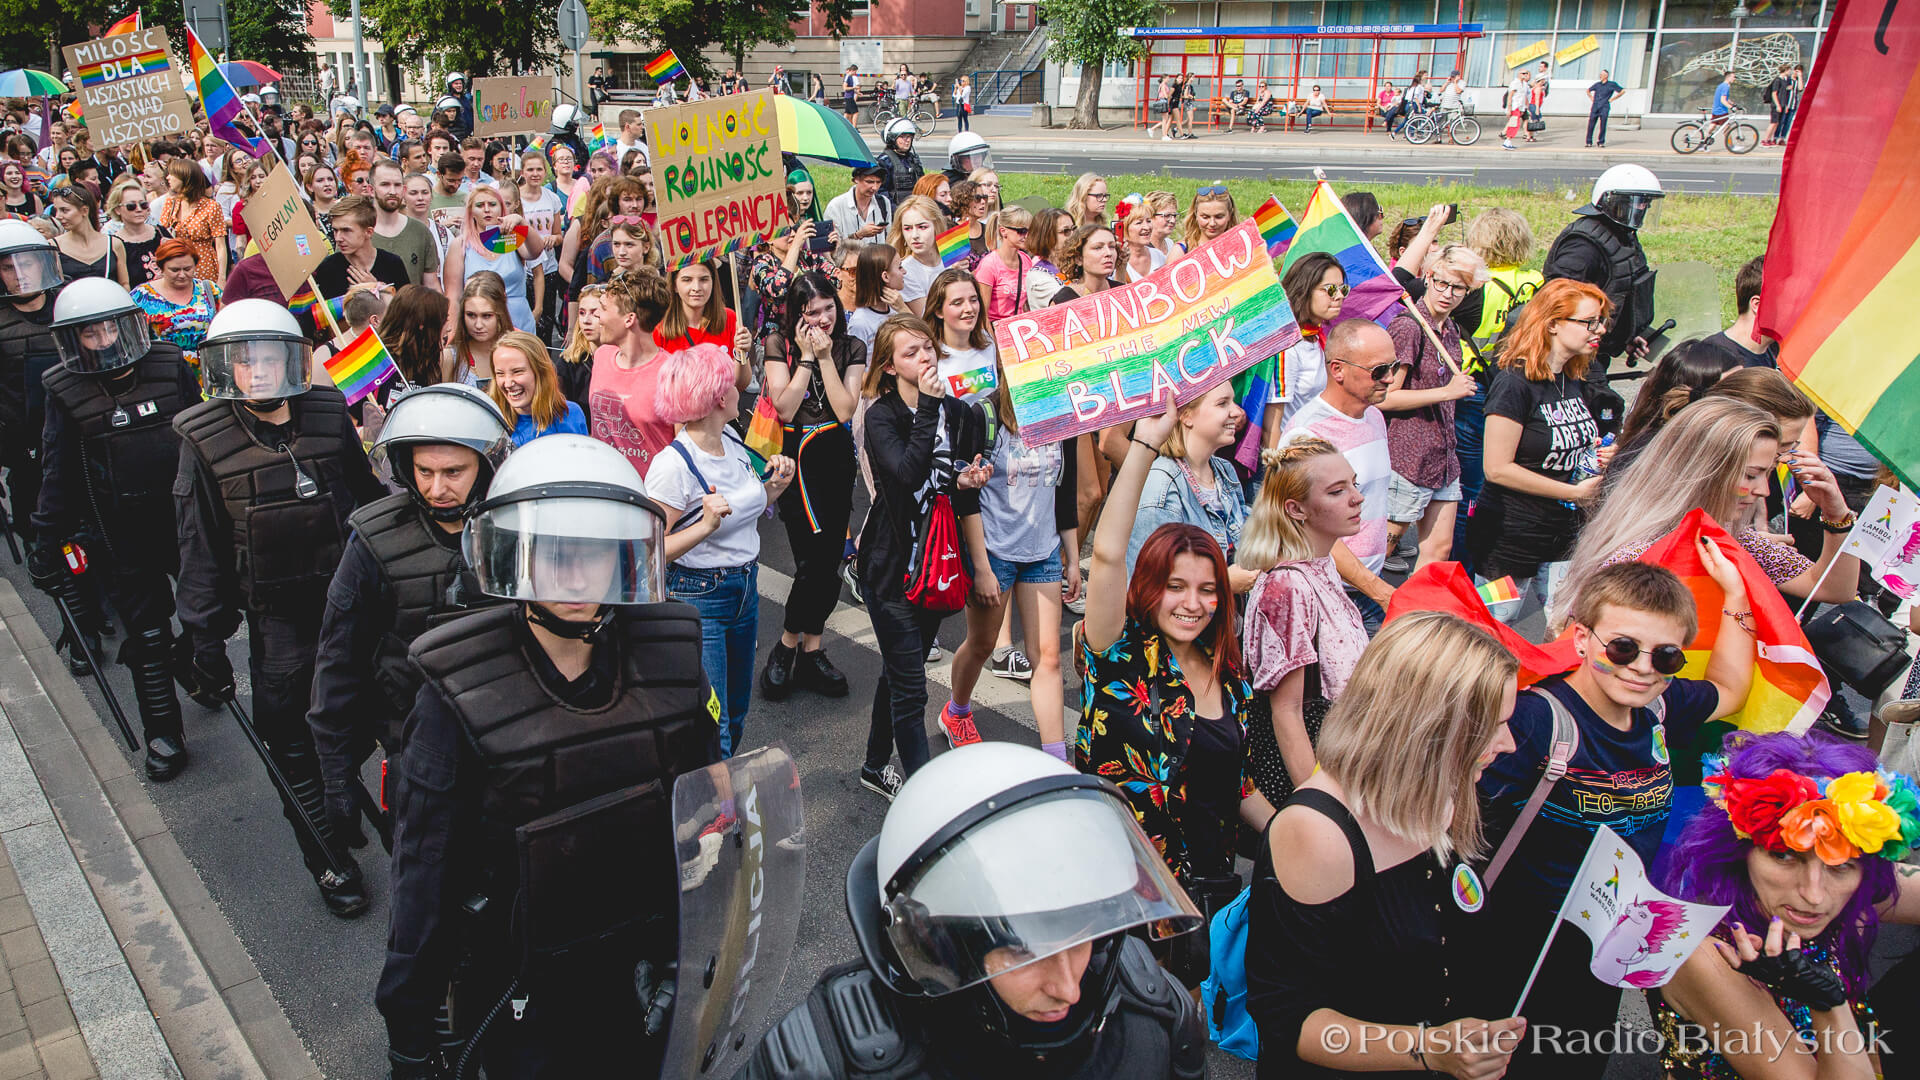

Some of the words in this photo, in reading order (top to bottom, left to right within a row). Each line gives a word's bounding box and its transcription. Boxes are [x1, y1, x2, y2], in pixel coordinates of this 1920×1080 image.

[74, 30, 158, 64] MIŁOŚĆ
[100, 57, 146, 82] DLA
[85, 73, 172, 106] WSZYSTKICH
[107, 96, 164, 124] PONAD
[510, 106, 518, 119] is
[653, 94, 770, 158] WOLNOŚĆ
[100, 113, 180, 146] WSZYSTKO
[664, 139, 773, 203] RÓWNOŚĆ
[258, 195, 299, 253] LEGAYLNI
[660, 192, 789, 256] TOLERANCJA
[1007, 228, 1253, 363] RAINBOW
[1044, 359, 1073, 381] IS
[1097, 333, 1158, 362] THE
[1180, 297, 1231, 336] NEW
[1066, 316, 1247, 423] BLACK
[1550, 424, 1580, 451] ARE
[1862, 521, 1892, 540] LAMBDA
[1573, 789, 1613, 815] TO
[1632, 784, 1669, 811] BE
